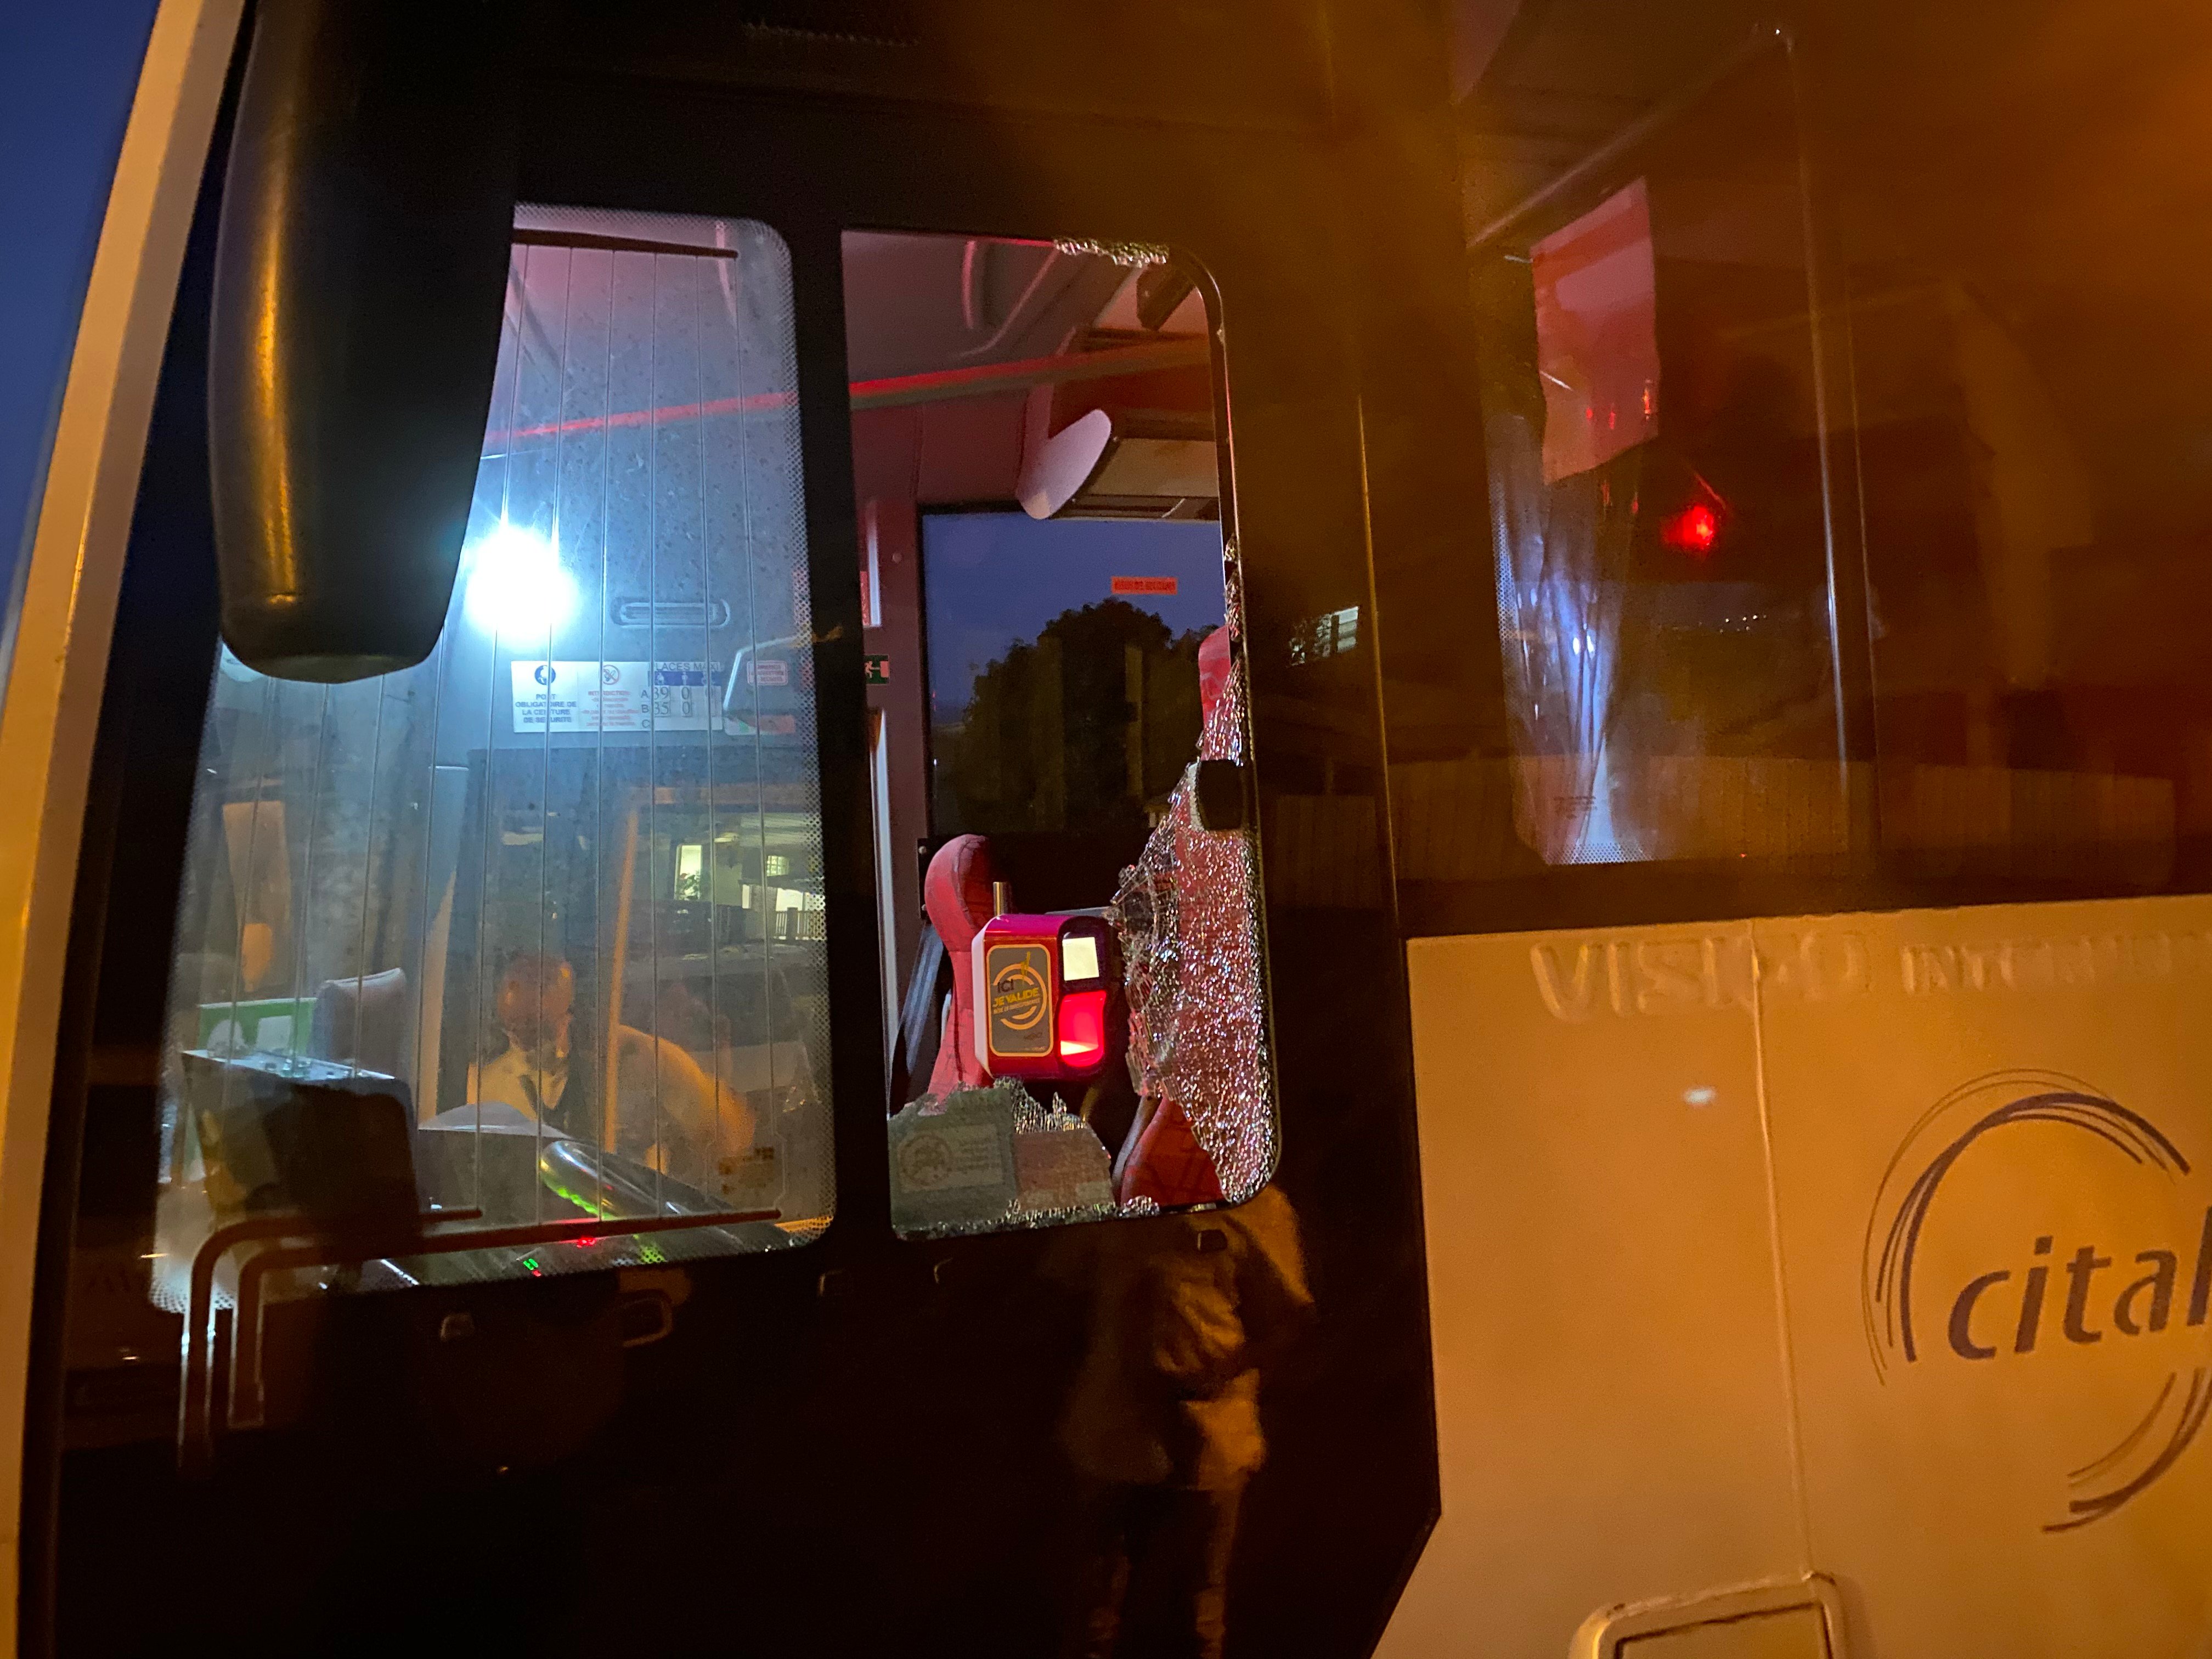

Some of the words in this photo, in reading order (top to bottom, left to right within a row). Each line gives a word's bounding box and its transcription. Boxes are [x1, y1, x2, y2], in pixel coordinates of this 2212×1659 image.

[641, 690, 649, 698] A
[681, 687, 690, 700] 0
[641, 704, 650, 713] B
[682, 701, 690, 714] 0
[642, 720, 650, 728] C
[1005, 988, 1039, 1003] VALIDE
